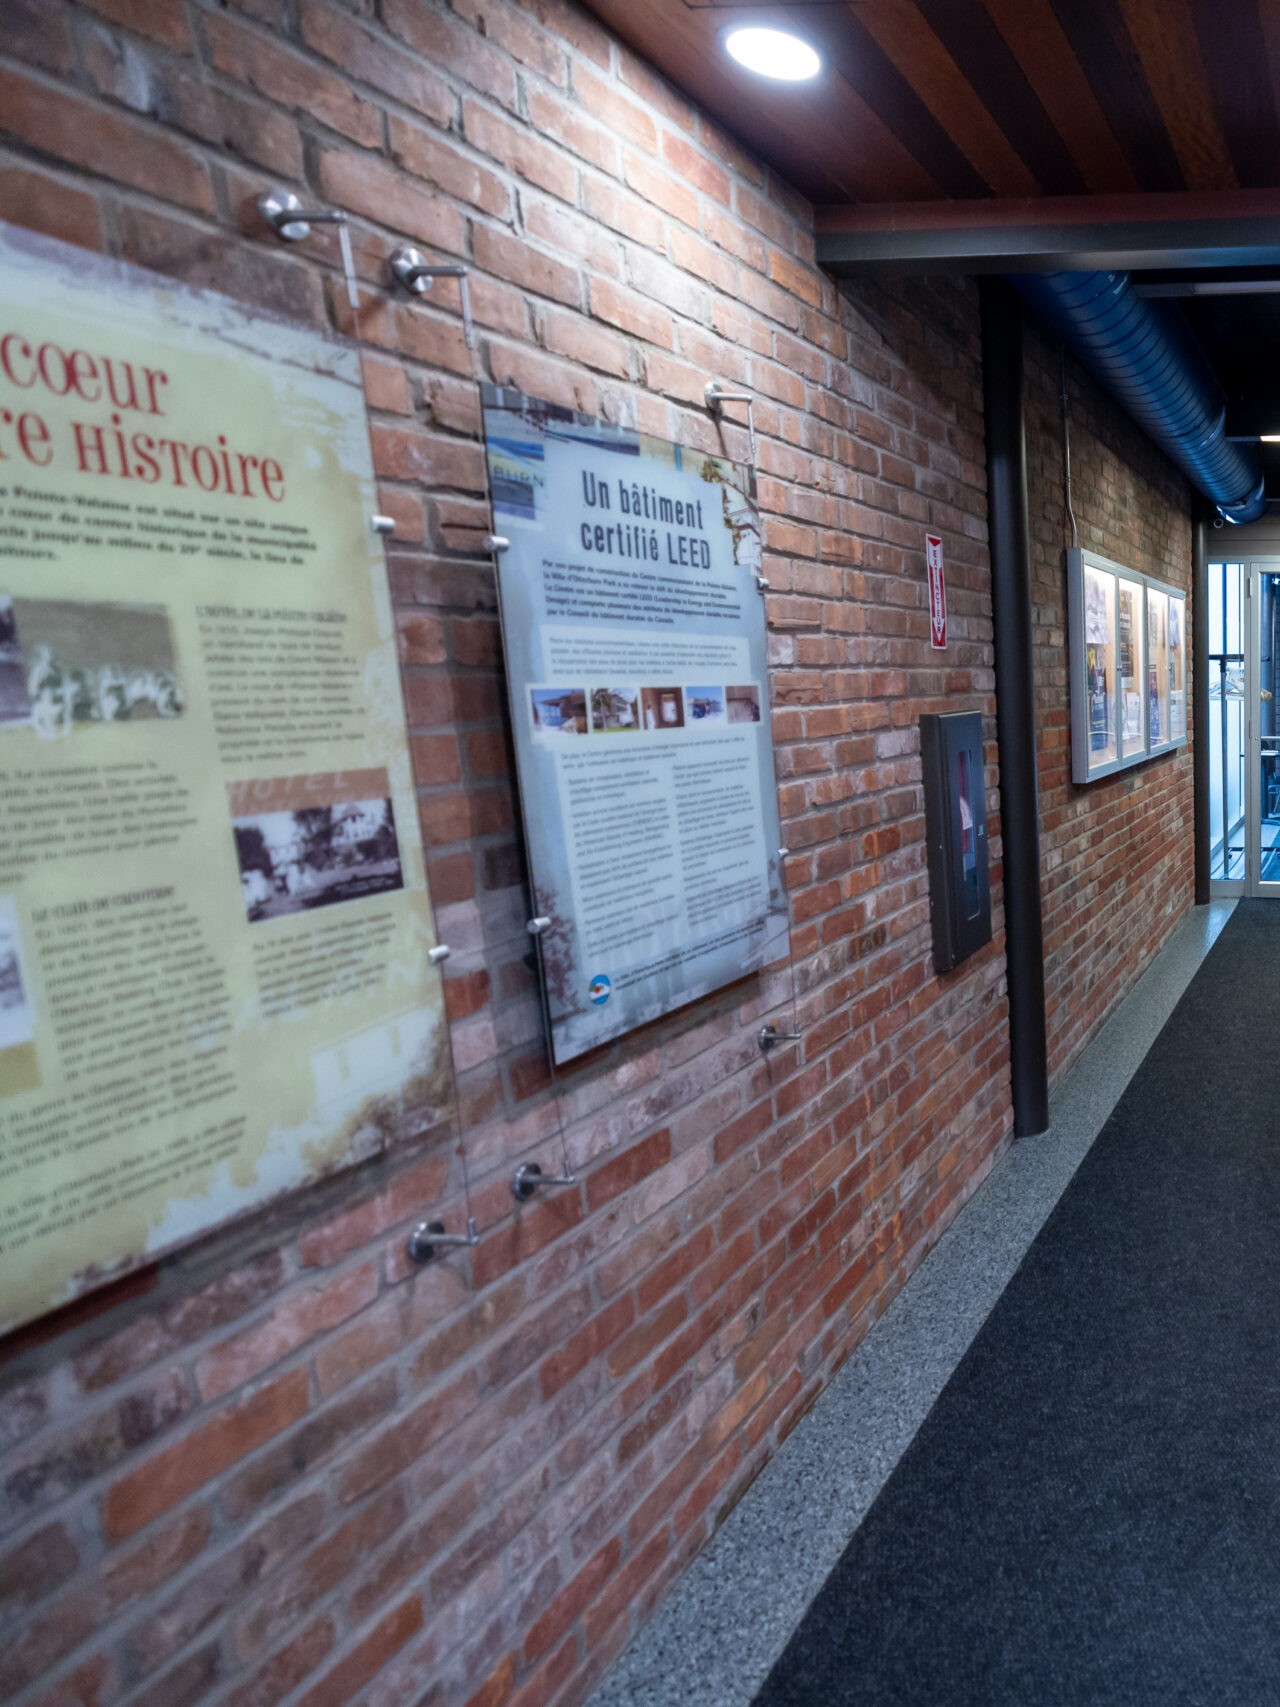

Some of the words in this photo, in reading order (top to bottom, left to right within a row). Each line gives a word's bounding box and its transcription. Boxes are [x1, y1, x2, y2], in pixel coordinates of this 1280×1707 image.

[0, 333, 168, 417] cœur
[582, 470, 610, 509] Un
[619, 479, 703, 530] bâtiment
[580, 522, 659, 561] certifié
[667, 532, 710, 570] LEED
[933, 550, 941, 633] EXTINCTEUR
